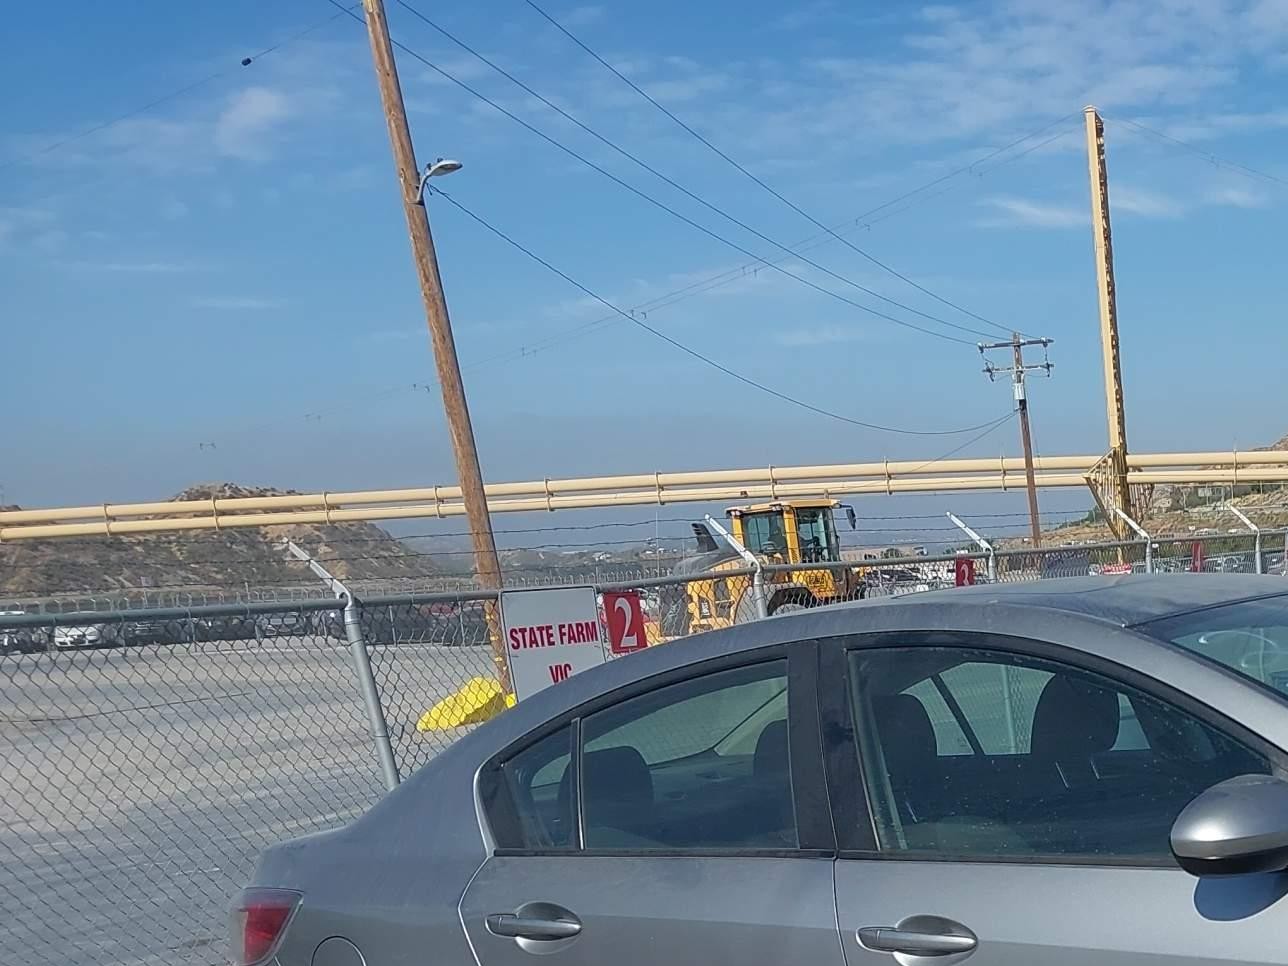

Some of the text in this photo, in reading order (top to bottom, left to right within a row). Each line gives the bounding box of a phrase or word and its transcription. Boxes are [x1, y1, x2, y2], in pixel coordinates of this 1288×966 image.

[509, 621, 598, 650] STATE FARM
[614, 597, 638, 648] 2
